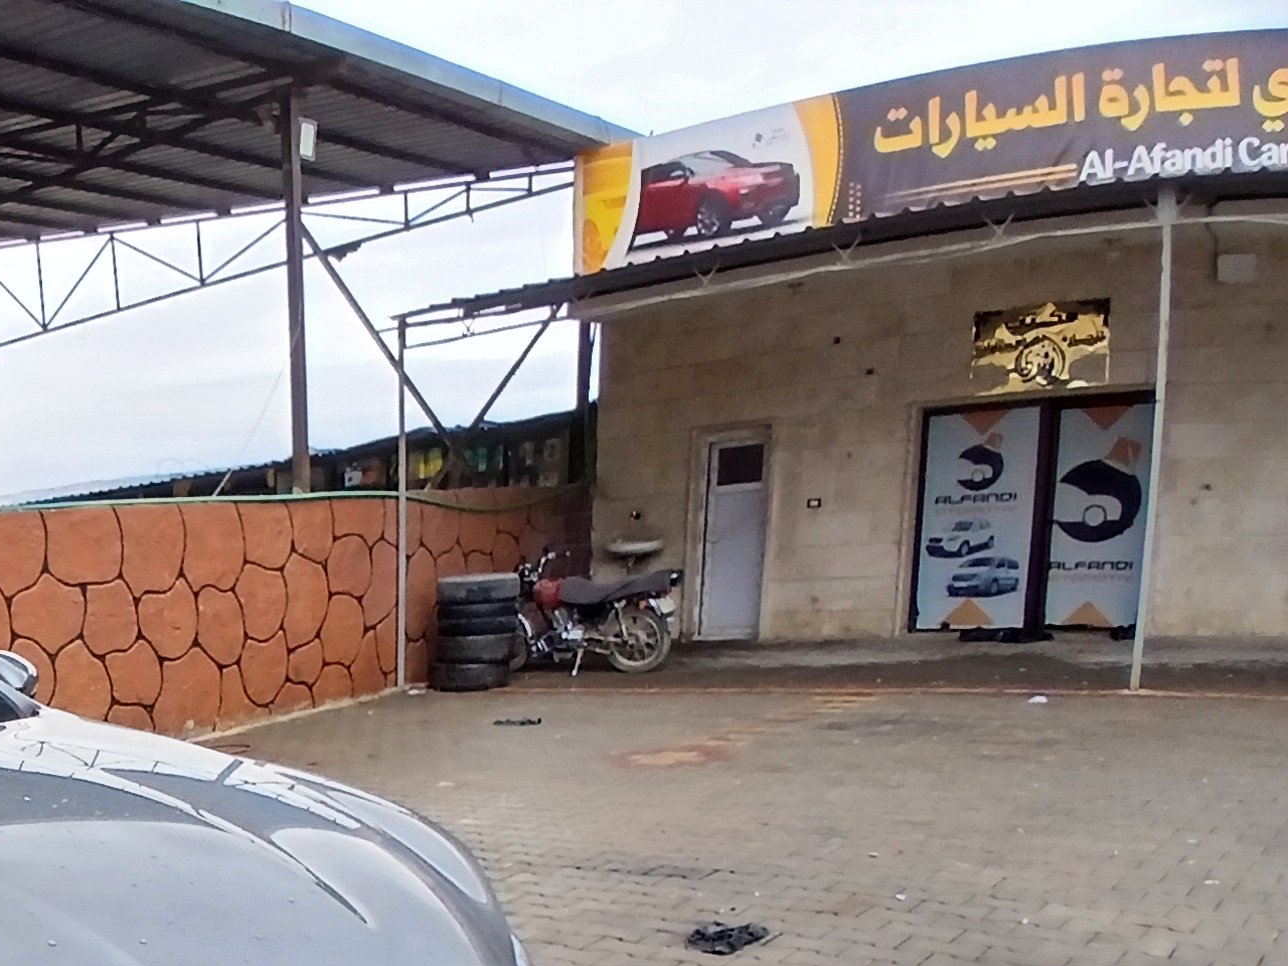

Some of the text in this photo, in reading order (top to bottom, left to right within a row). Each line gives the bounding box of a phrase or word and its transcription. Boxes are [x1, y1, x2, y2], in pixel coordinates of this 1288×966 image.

[874, 72, 1085, 158] السيارات
[1099, 57, 1240, 131] لتجارة
[1080, 137, 1233, 181] Al-Afandi
[935, 492, 1017, 505] ALFANDI
